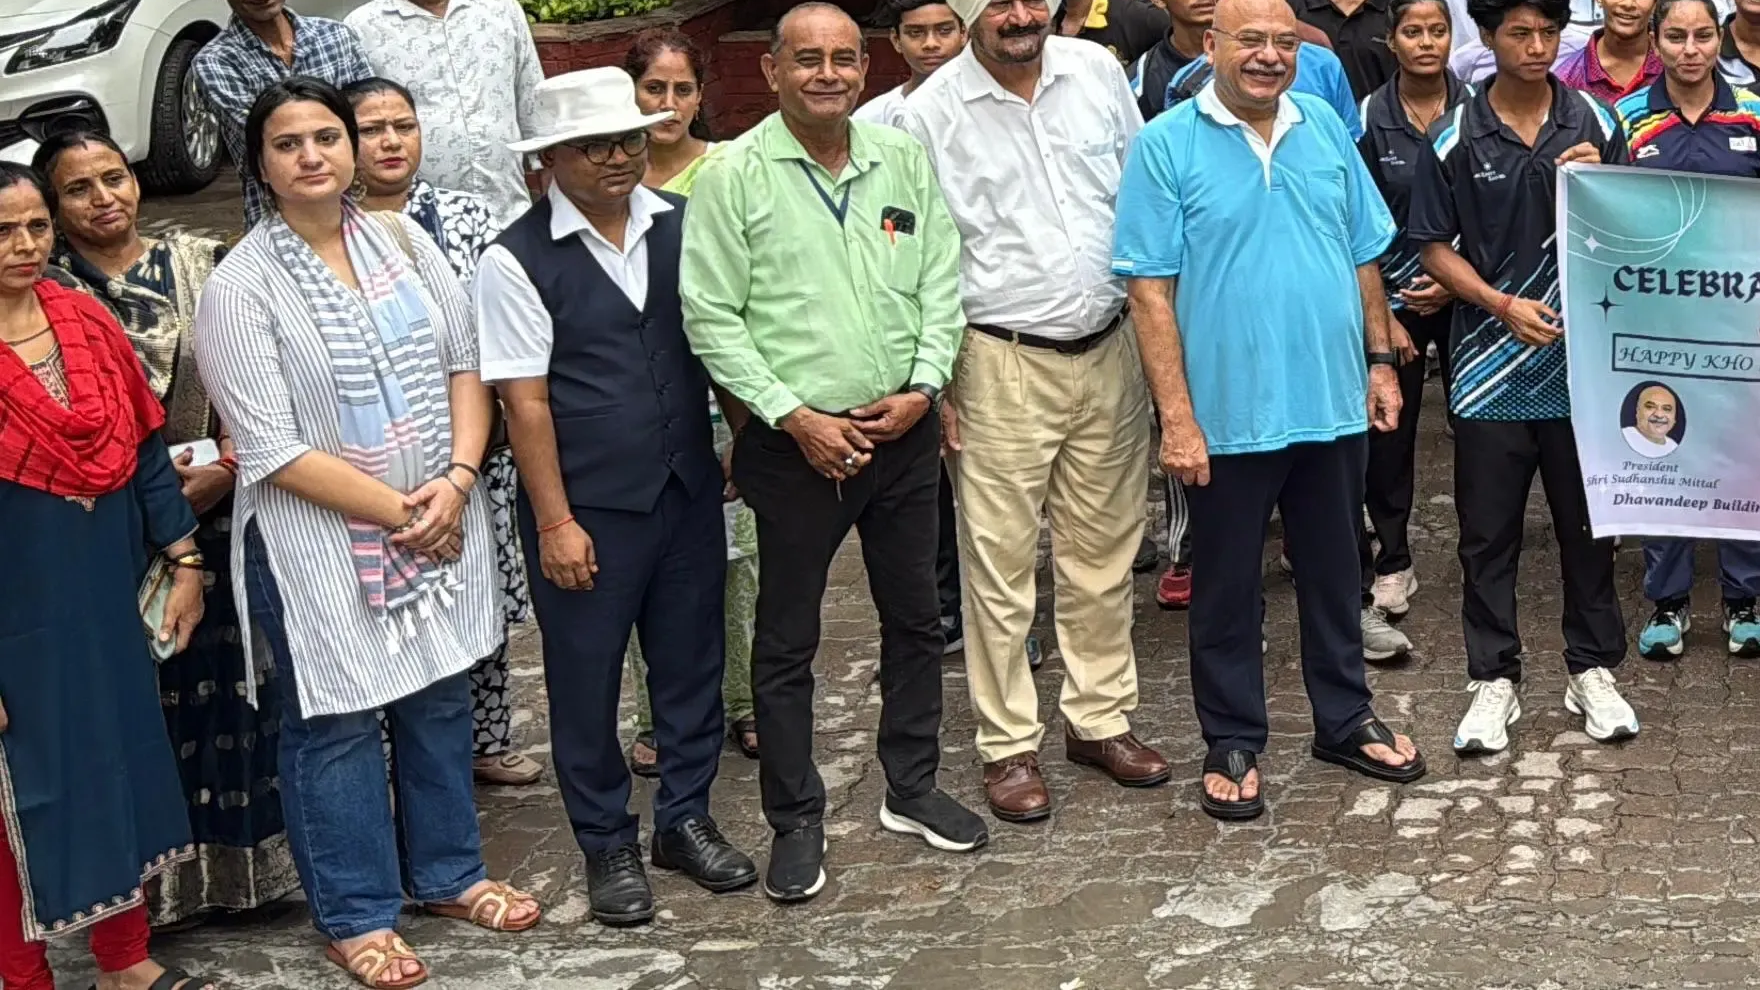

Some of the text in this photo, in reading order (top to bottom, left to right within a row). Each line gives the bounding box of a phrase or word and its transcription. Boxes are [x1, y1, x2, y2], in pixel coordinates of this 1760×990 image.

[1618, 346, 1697, 370] HAPPY
[1701, 354, 1753, 372] KHO
[1622, 461, 1679, 473] President
[1611, 473, 1675, 486] Sudhanshu
[1678, 478, 1721, 490] Mittal
[1613, 493, 1708, 511] Dhawandeep
